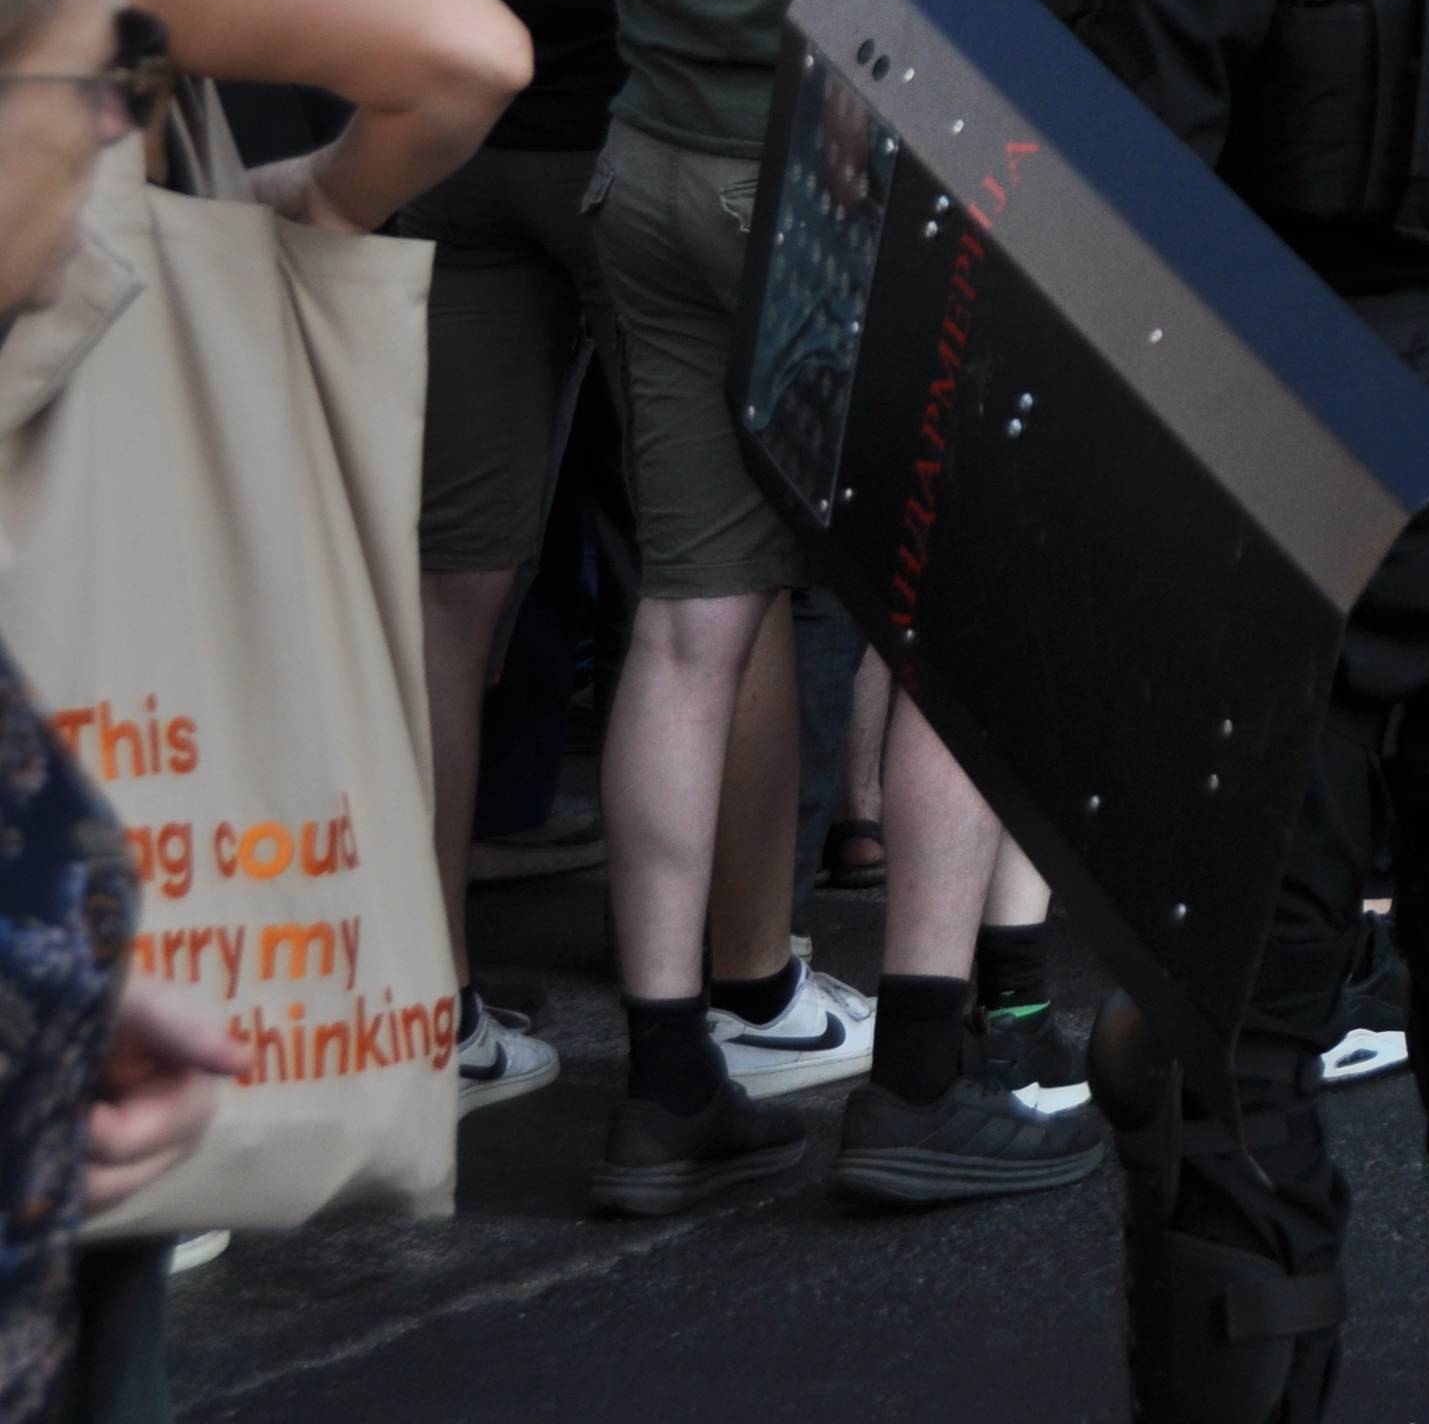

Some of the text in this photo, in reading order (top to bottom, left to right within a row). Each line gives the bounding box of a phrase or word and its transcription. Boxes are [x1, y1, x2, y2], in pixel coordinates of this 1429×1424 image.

[47, 692, 199, 780] This
[124, 820, 195, 900] ag
[130, 916, 360, 1002] arry my
[228, 986, 457, 1089] thinking
